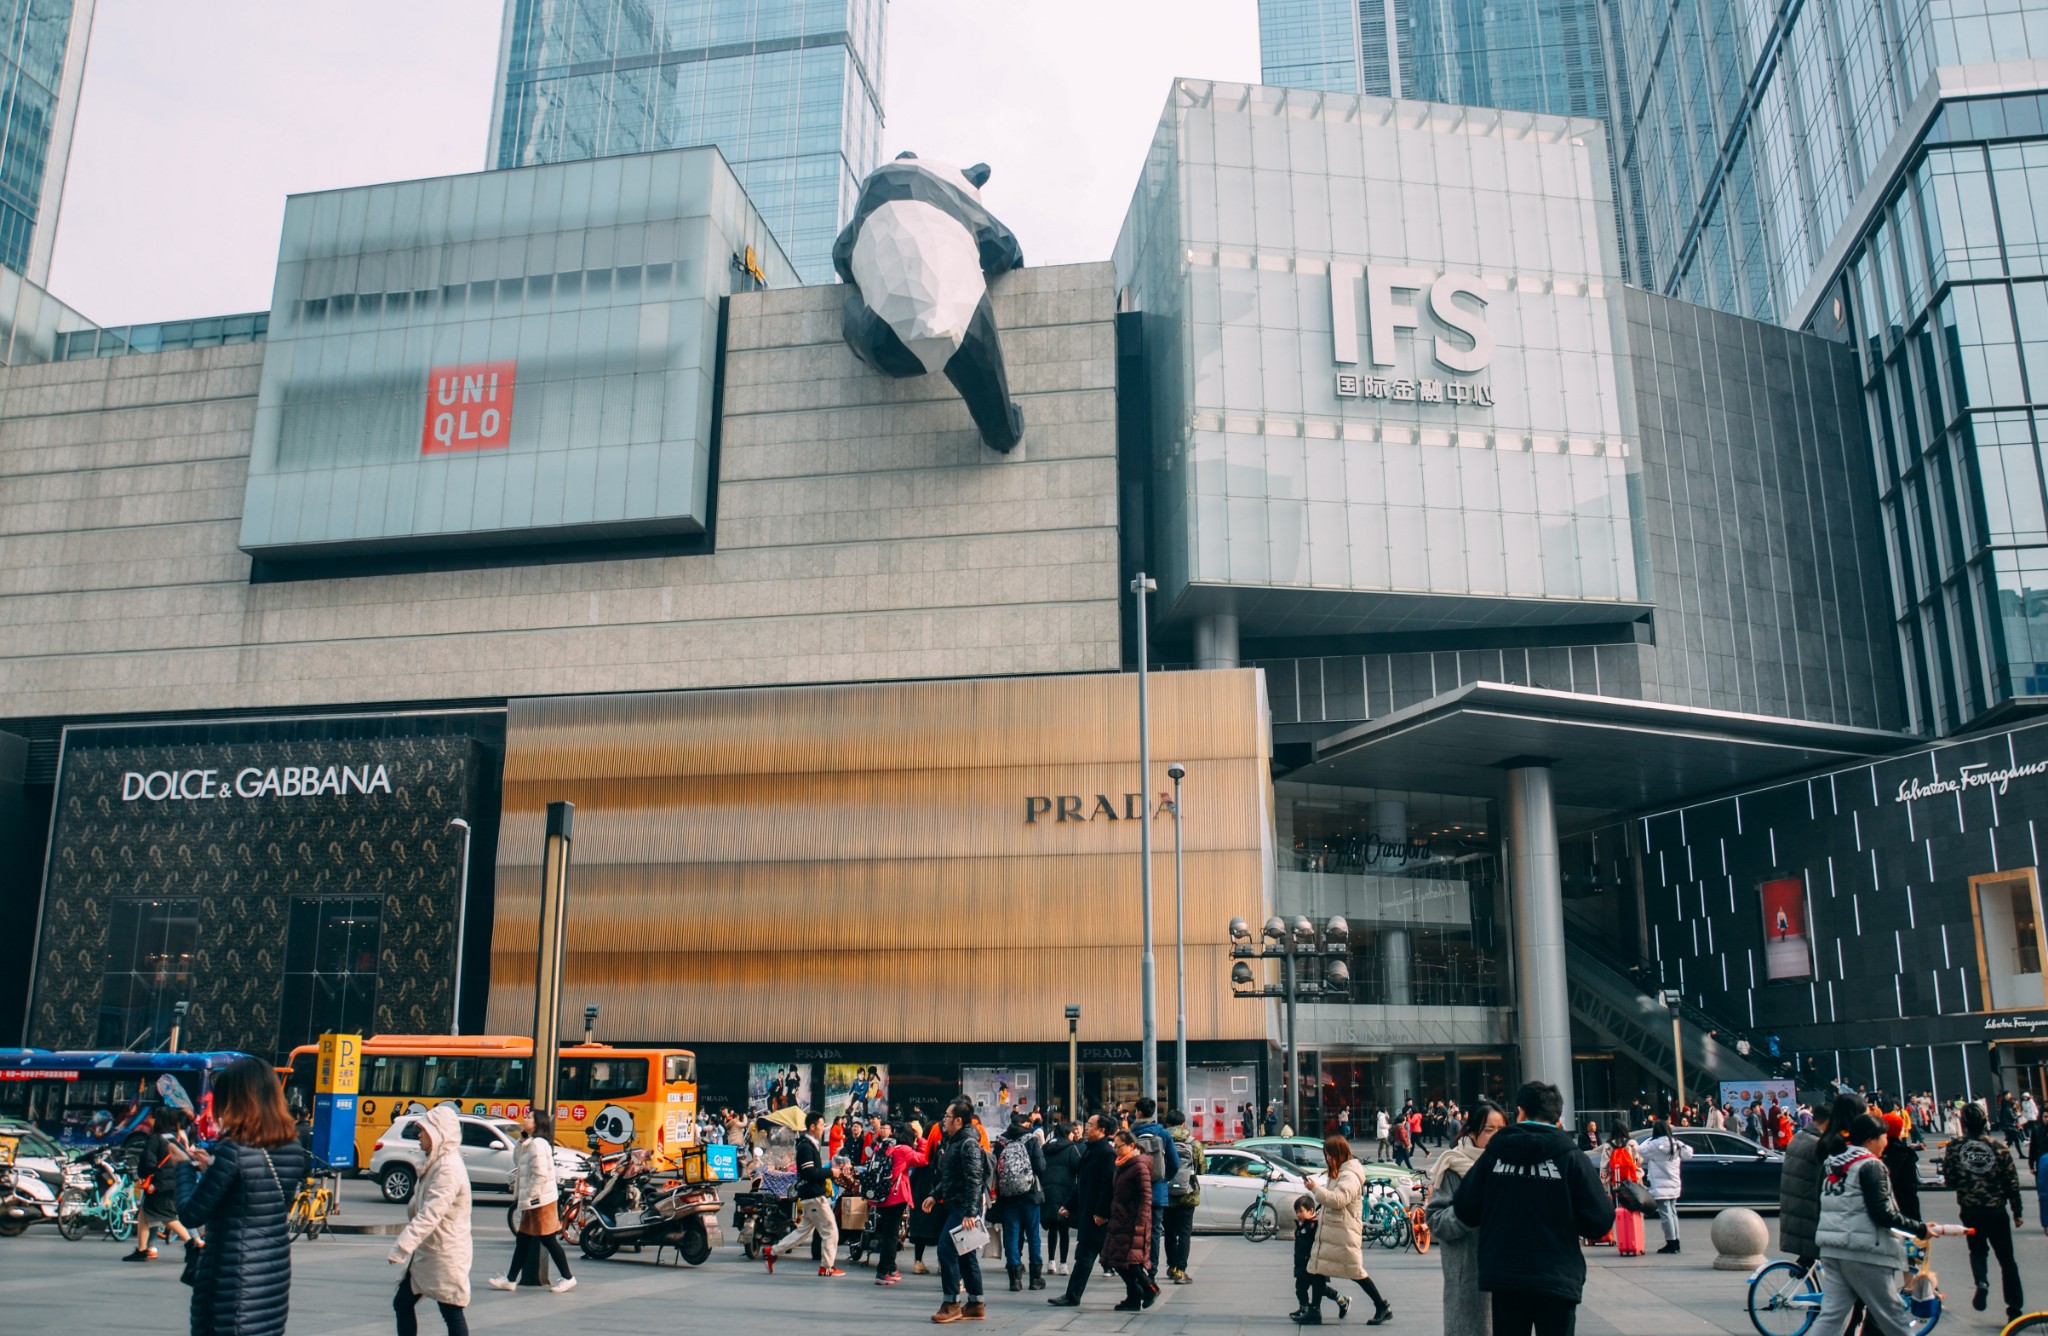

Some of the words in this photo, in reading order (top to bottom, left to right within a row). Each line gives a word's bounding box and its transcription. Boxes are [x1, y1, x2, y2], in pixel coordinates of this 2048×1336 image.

[1328, 261, 1497, 374] IFS
[438, 372, 499, 406] UNI
[1336, 372, 1496, 408] 国际金融中心
[434, 408, 500, 447] QLO
[121, 769, 219, 801] DOLCE
[219, 781, 233, 799] &
[235, 763, 392, 798] GABBANA
[1895, 773, 1961, 803] Salvatore
[1959, 760, 2048, 796] Ferragamo
[1025, 791, 1184, 824] PRADA
[340, 1040, 353, 1067] P
[795, 1049, 842, 1060] PRADA
[1082, 1048, 1132, 1059] PRADA
